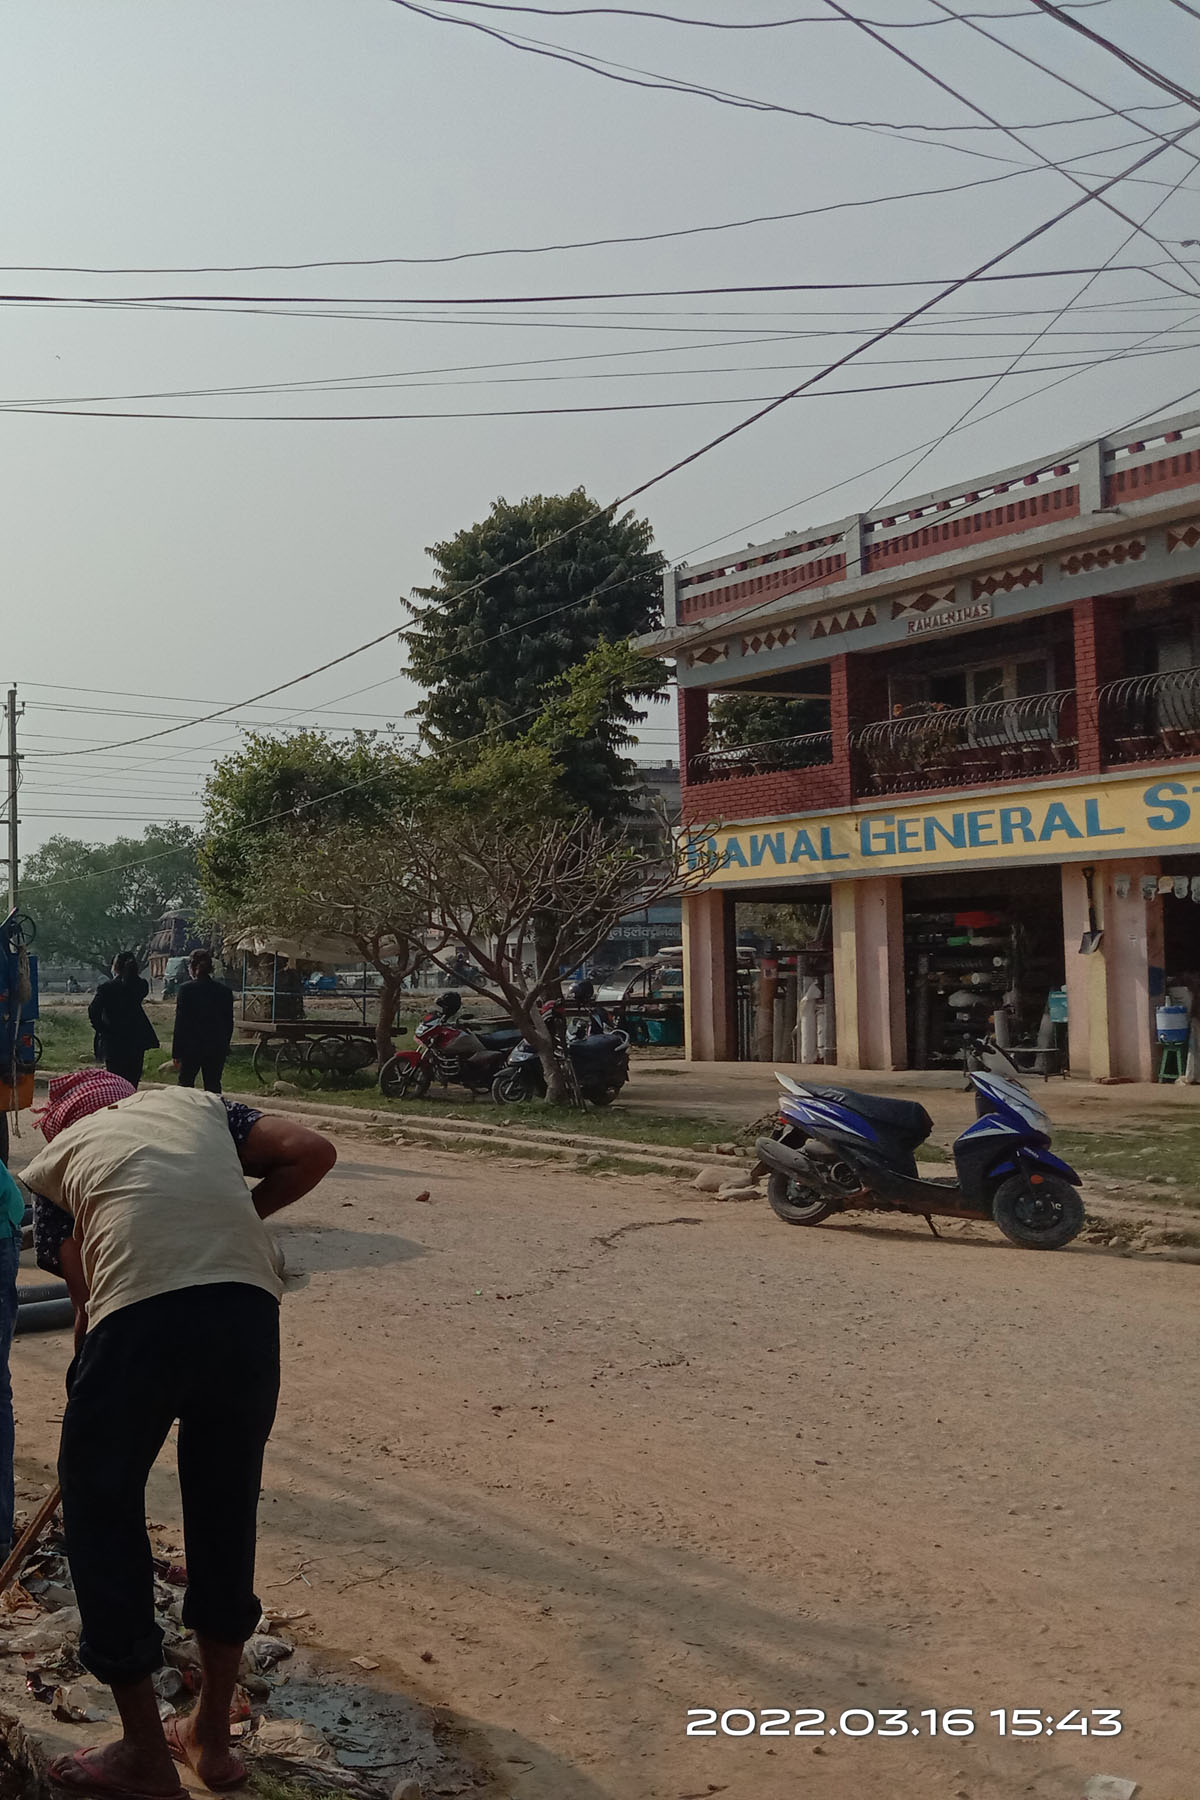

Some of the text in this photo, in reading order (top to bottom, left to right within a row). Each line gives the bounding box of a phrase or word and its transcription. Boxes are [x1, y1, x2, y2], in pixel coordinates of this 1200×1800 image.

[686, 781, 1200, 870] RAWAL GENERAL S
